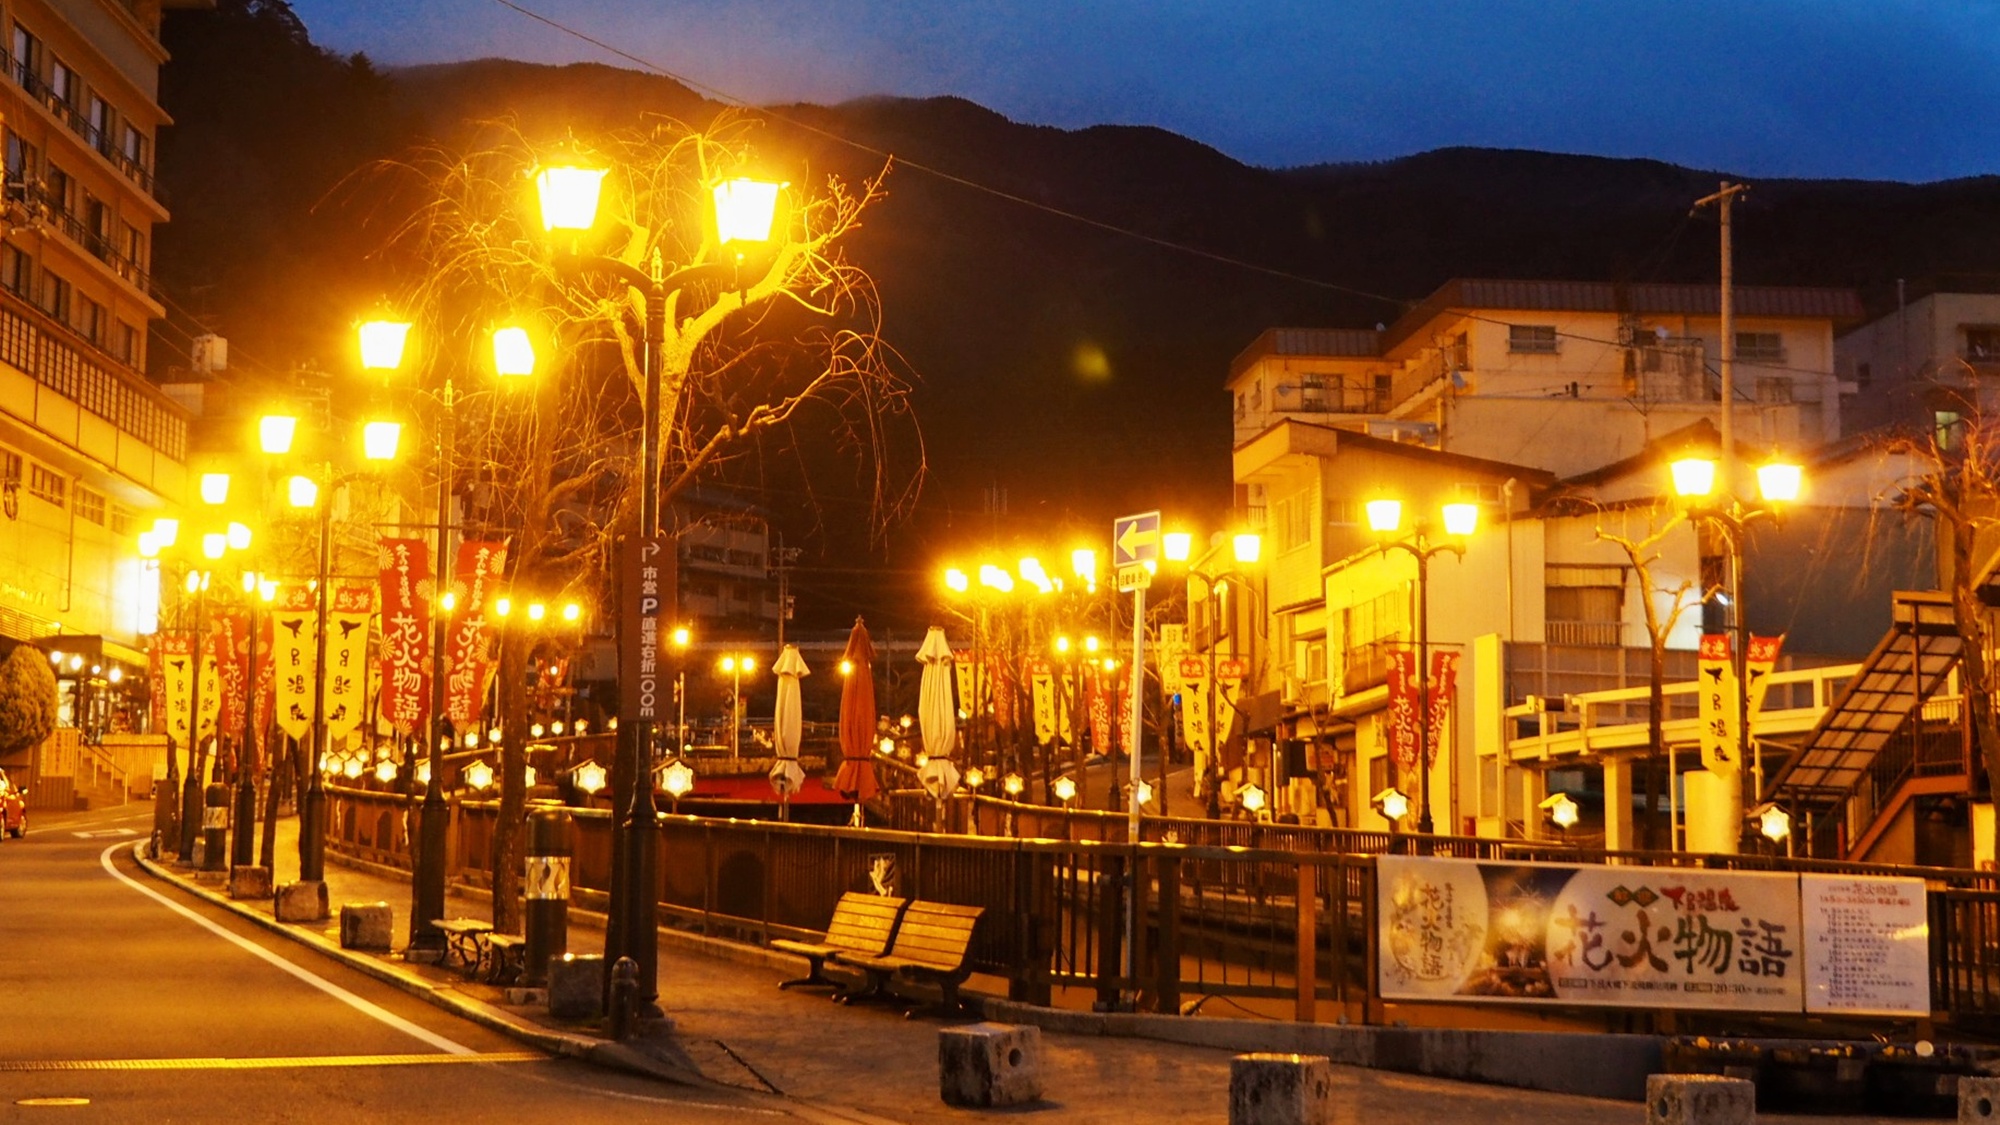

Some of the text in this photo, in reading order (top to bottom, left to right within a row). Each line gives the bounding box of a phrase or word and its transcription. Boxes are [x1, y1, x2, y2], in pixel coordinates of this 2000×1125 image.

[170, 660, 187, 730] 下呂温泉
[281, 619, 308, 721] 下呂温泉
[390, 612, 423, 720] 花火物語
[1036, 679, 1051, 733] 下呂温泉
[1392, 694, 1414, 762] 花火物語
[1705, 667, 1730, 763] 下呂温泉
[1420, 883, 1444, 976] 花火物語
[1660, 885, 1740, 912] 下呂温泉
[1554, 903, 1793, 978] 花火物語
